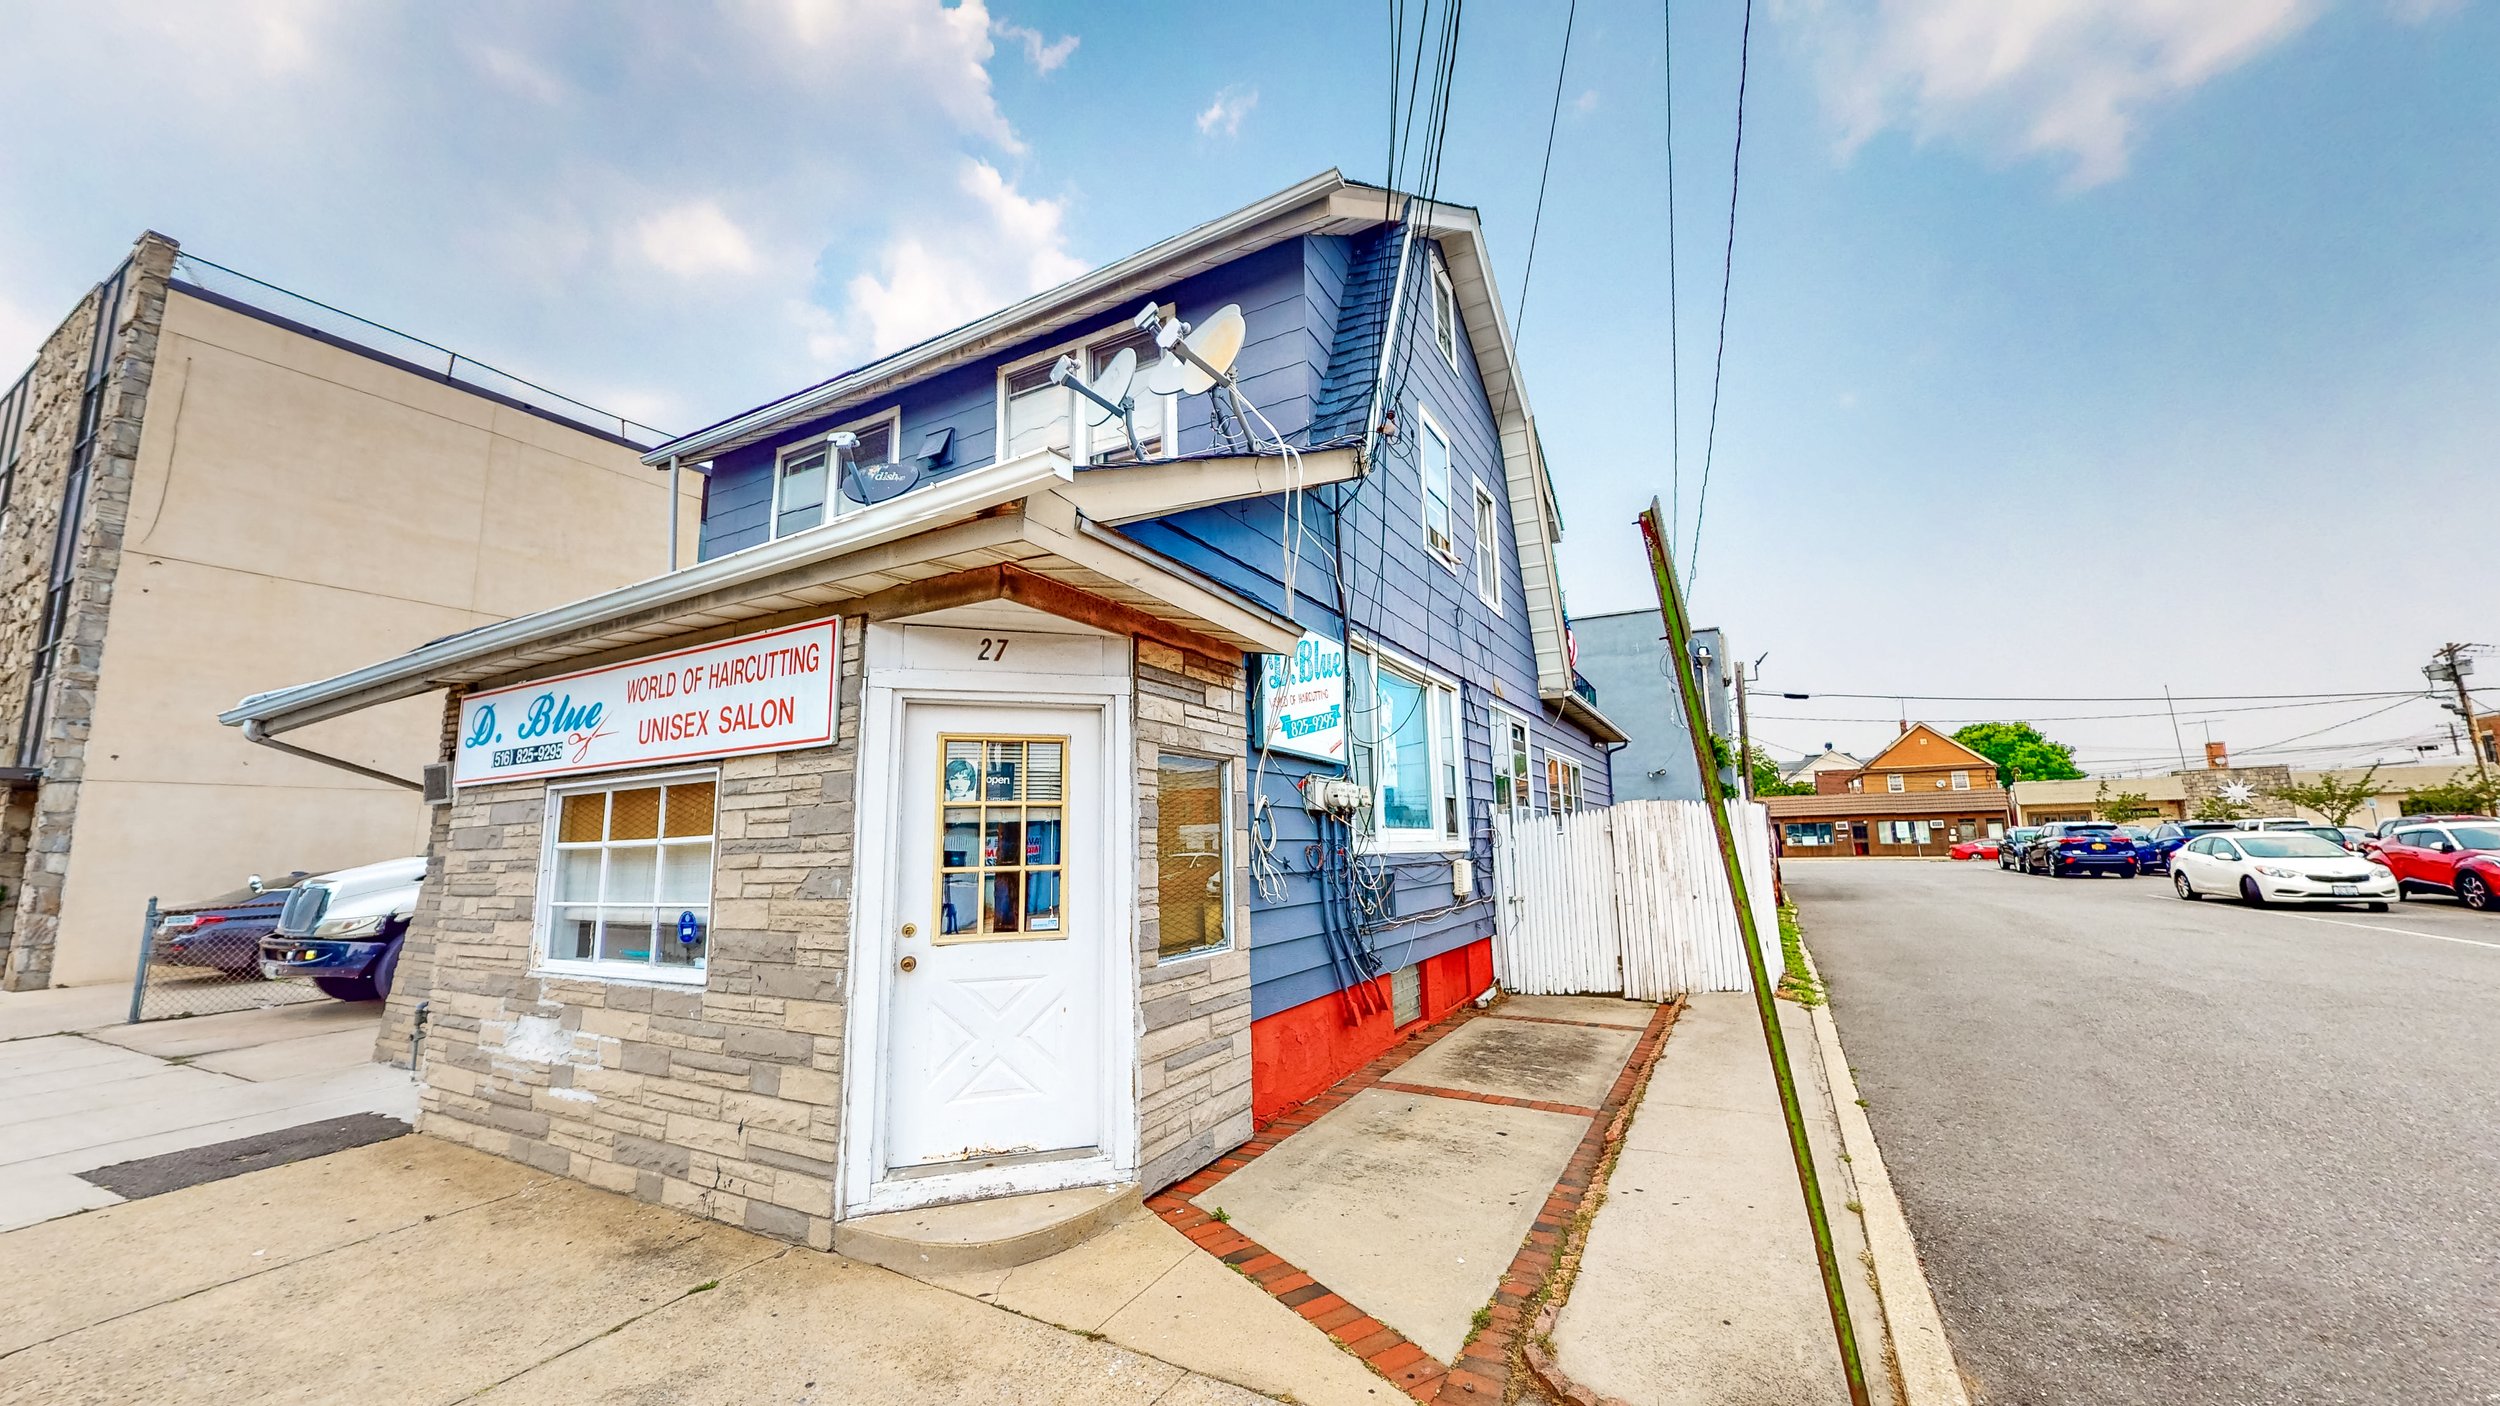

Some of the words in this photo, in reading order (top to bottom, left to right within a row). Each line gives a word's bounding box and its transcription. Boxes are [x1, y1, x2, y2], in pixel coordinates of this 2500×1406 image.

[874, 471, 899, 481] dish
[977, 637, 1010, 662] 27
[1294, 640, 1344, 683] Blue
[627, 672, 677, 704] WORLD
[682, 666, 704, 695] OF
[708, 642, 820, 690] HAIRCUTTING
[1298, 688, 1329, 704] HAIRCUTTING
[465, 702, 502, 749] D.
[517, 691, 604, 740] Blue
[638, 709, 710, 745] UNISEX
[718, 696, 795, 734] SALON
[1291, 712, 1335, 738] 825-9295
[492, 750, 514, 768] (516)
[515, 742, 564, 763] 825-9295
[986, 776, 1011, 786] open
